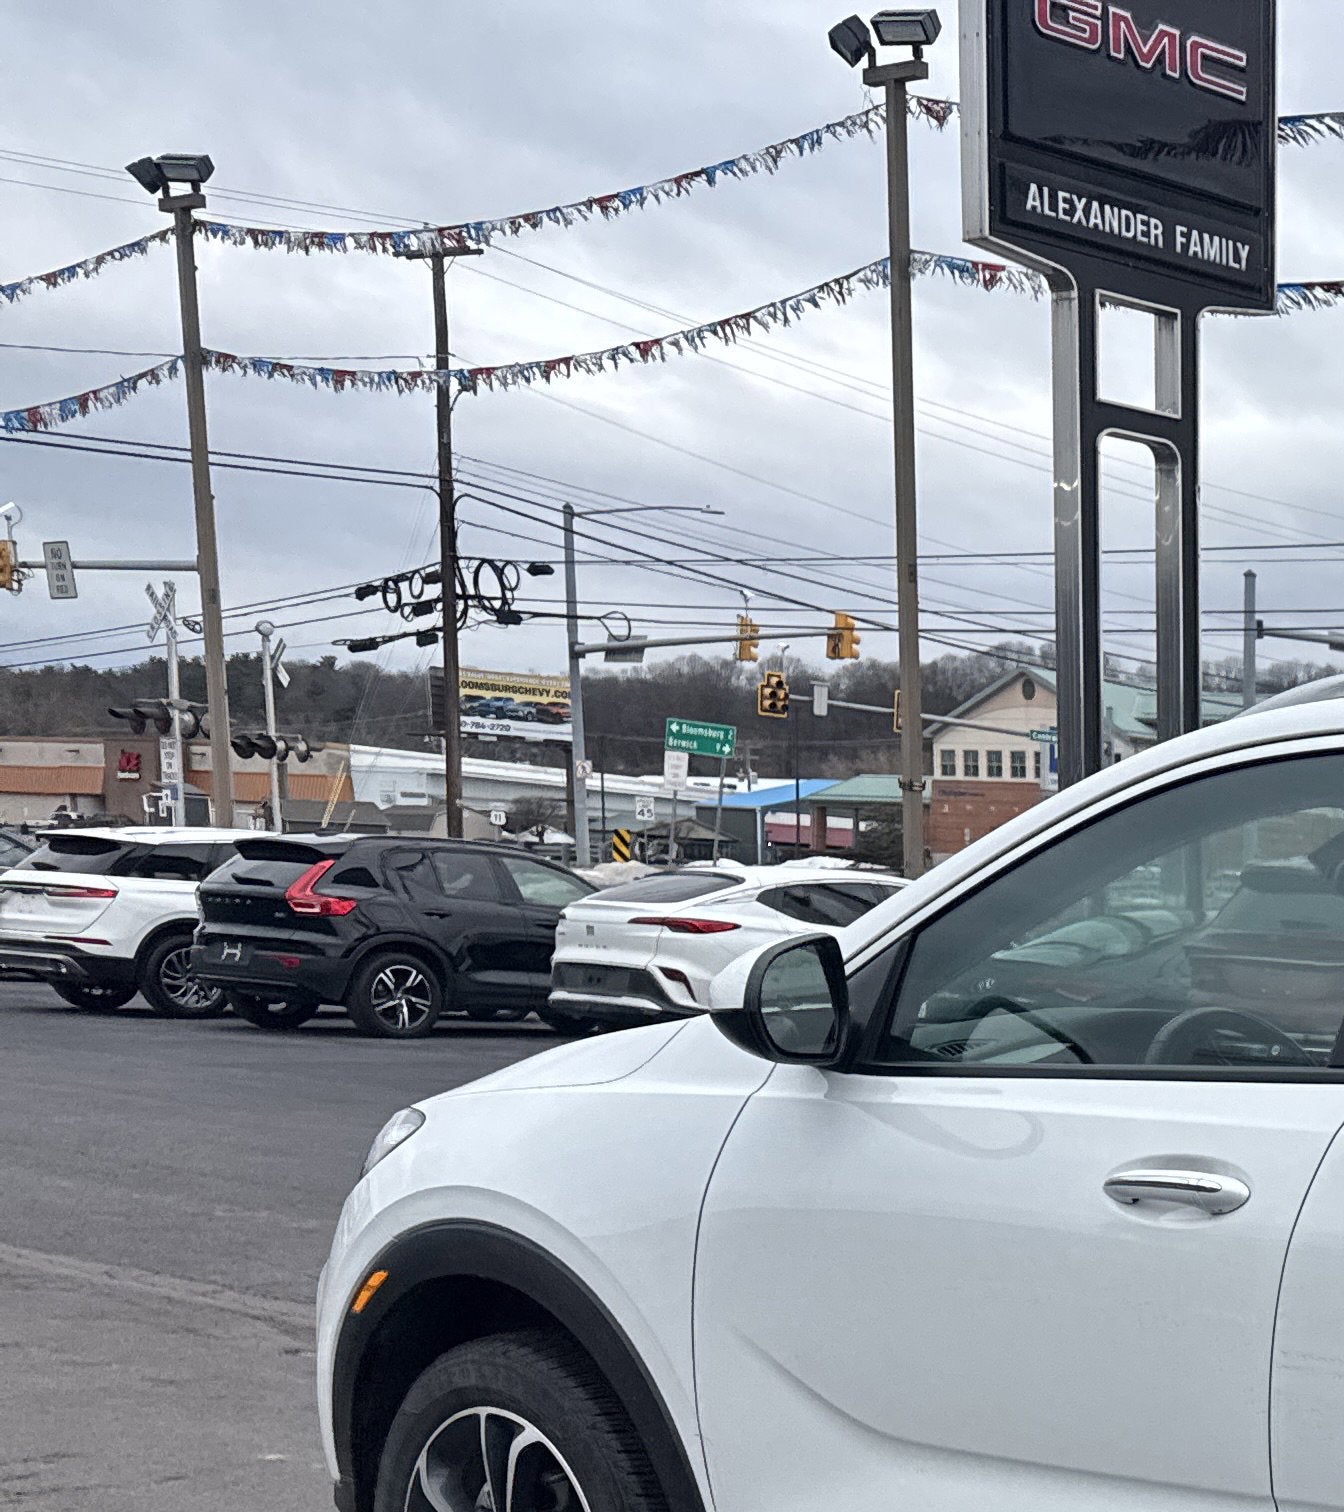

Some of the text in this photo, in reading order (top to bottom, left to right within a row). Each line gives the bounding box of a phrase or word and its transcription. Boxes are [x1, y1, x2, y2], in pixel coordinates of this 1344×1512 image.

[1034, 0, 1247, 102] GMC
[1025, 183, 1250, 272] ALEXANDER FAMILY
[459, 679, 571, 700] OOMSBURGCHEVY.CO
